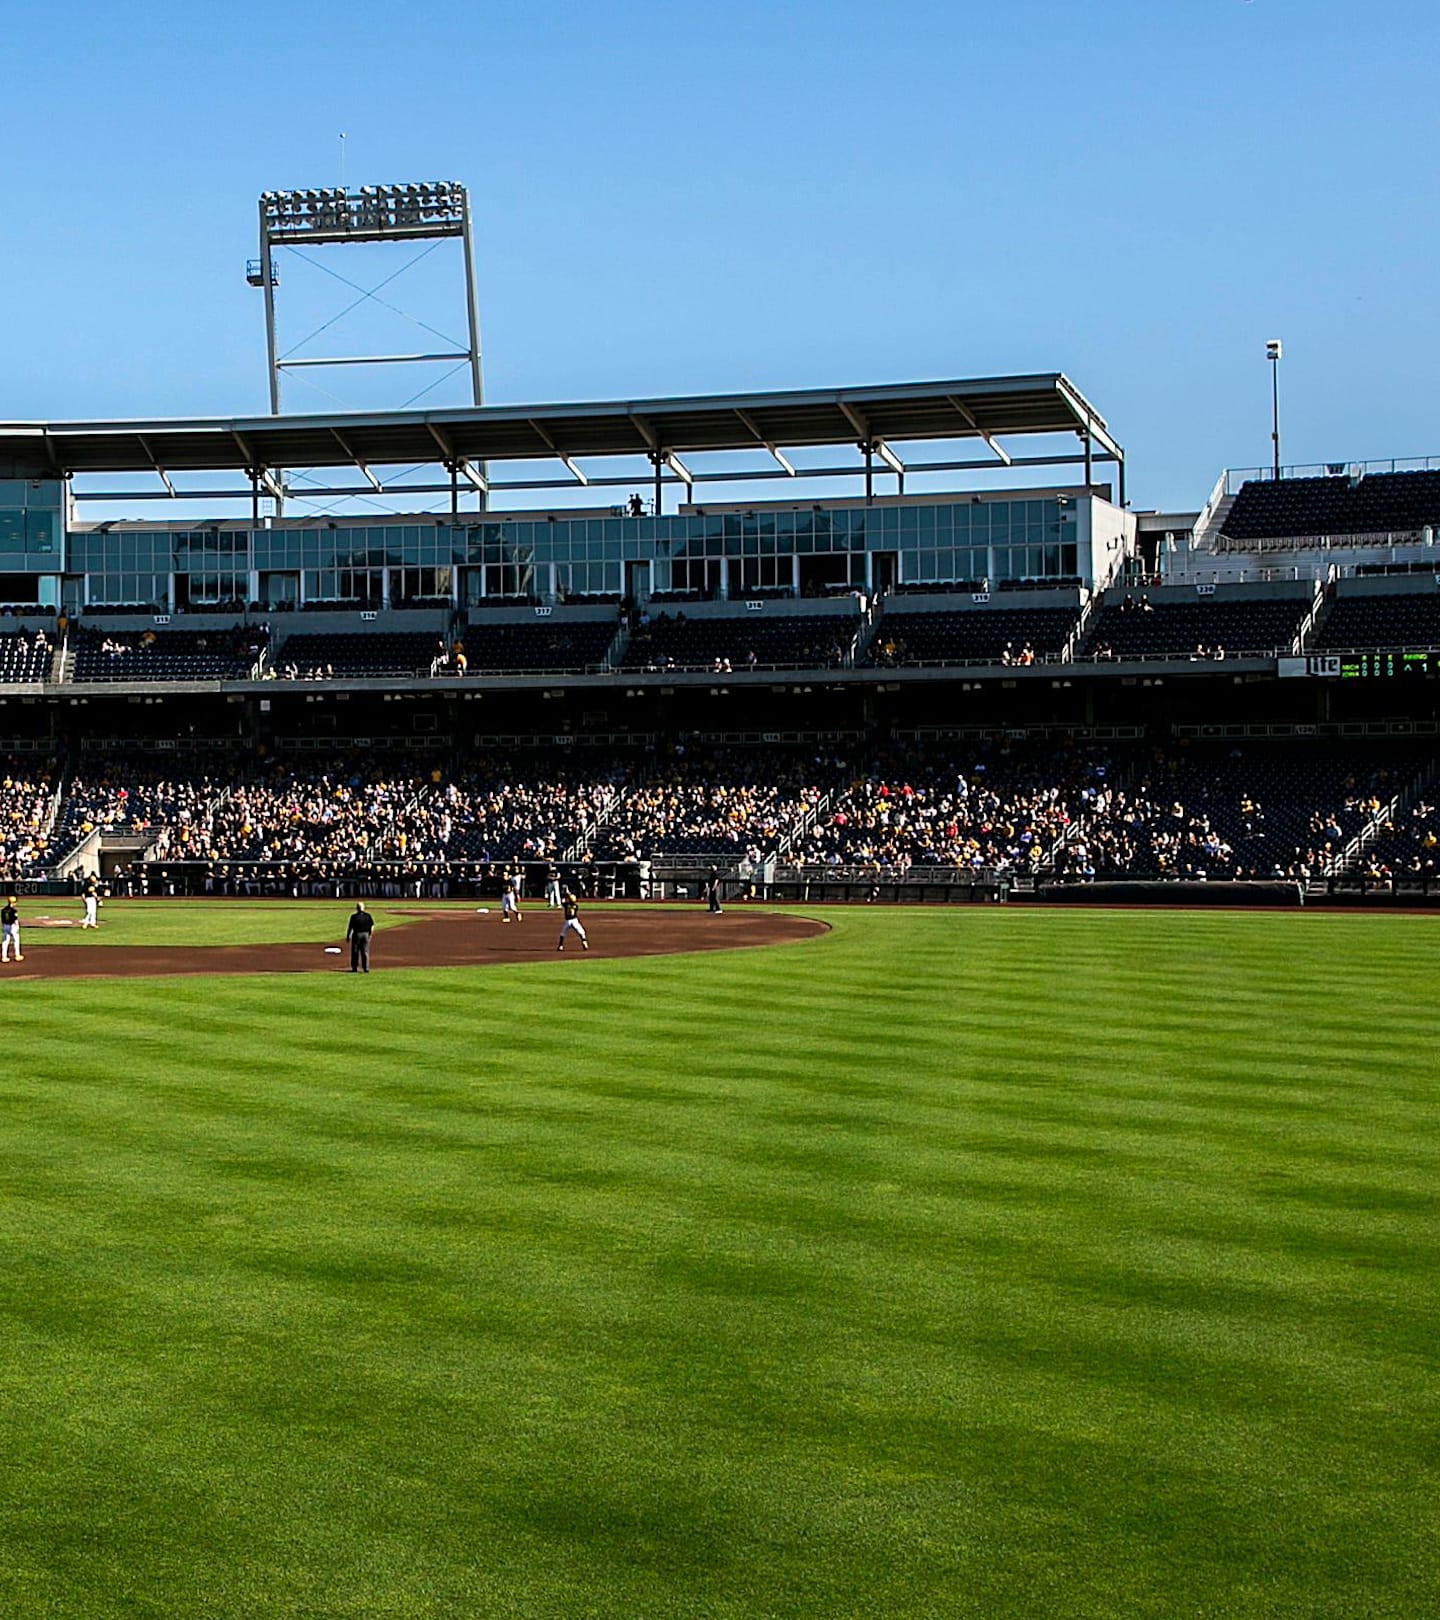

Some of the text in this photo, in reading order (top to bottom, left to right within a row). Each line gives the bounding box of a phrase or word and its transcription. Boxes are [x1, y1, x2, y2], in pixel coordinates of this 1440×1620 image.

[536, 607, 551, 615] 217
[1306, 657, 1338, 676] Lite
[1422, 663, 1427, 672] 1
